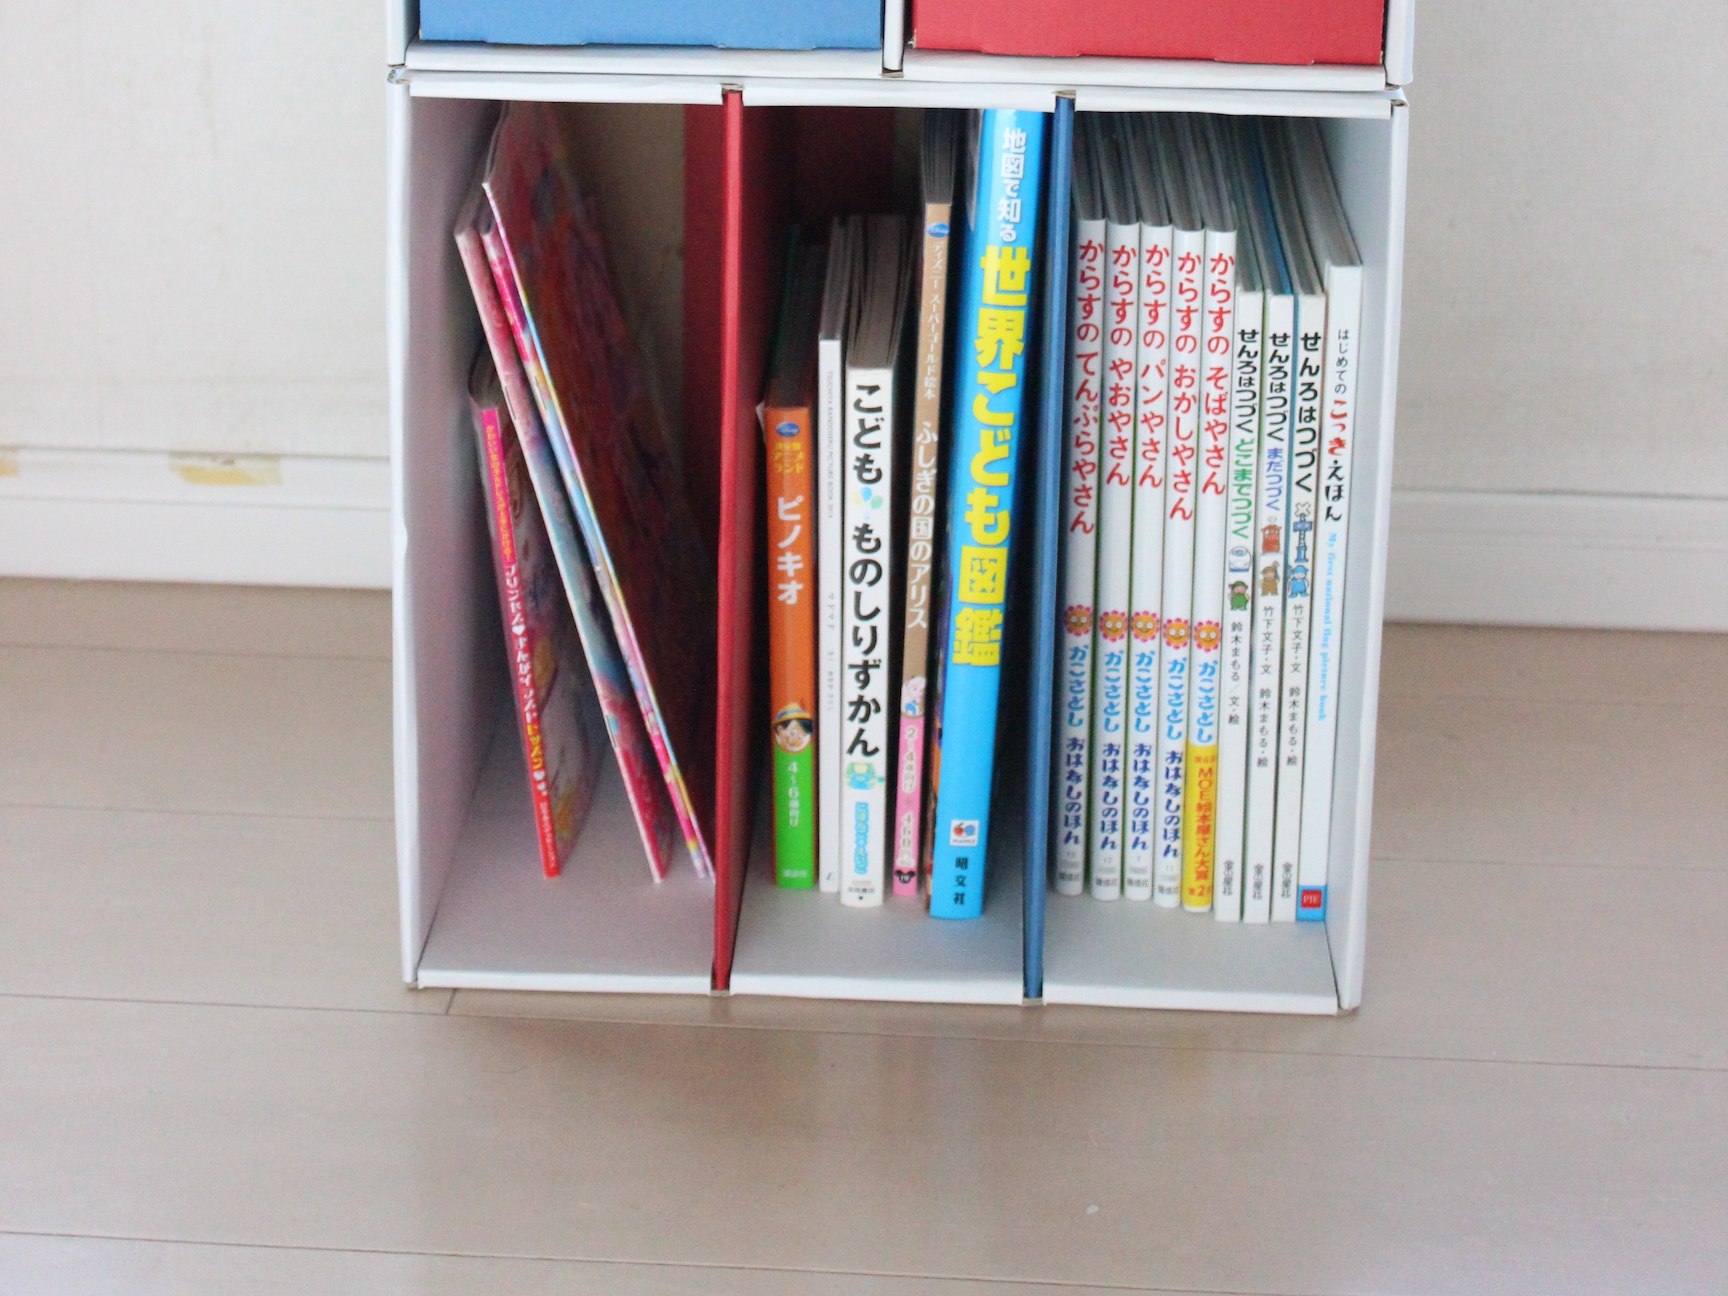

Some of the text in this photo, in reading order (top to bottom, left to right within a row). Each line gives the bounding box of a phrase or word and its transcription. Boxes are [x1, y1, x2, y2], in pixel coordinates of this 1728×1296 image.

[923, 241, 943, 401] ディズニー スーパーゴールド絵本
[1105, 244, 1137, 487] からすの やおやさん
[1138, 244, 1170, 489] からすの パンやさん
[1201, 253, 1235, 495] からすの そばやさん
[1333, 328, 1350, 396] はじめての
[952, 127, 1031, 667] 地図で知る 世界こども図鑑
[1070, 239, 1104, 535] からすの てんぷらやさん
[1169, 252, 1201, 521] からすの おかしやさん
[1230, 329, 1259, 539] せんろはつづく どこまでつづく
[1265, 332, 1291, 511] せんろはつづく まだつづく
[1295, 332, 1321, 494] せんろはつづく
[776, 495, 804, 605] ピノキオ
[846, 383, 884, 759] こども ものしりずかん
[907, 422, 939, 630] ふしぎの国のアリス
[1067, 644, 1090, 728] かこさとし
[1103, 650, 1125, 733] かこさとし
[1134, 650, 1155, 733] かこさとし
[1166, 657, 1187, 741] かこさとし
[1195, 660, 1218, 744] かこさとし
[1257, 605, 1274, 768] 竹下文子・文 鈴木まもる・絵
[1286, 604, 1304, 767] 竹下文子・文 鈴木まもる・絵
[1063, 737, 1085, 846] おはなしのほん
[1100, 743, 1121, 851] おはなしのほん
[1131, 743, 1151, 852] おはなしのほん
[1162, 750, 1183, 859] おはなしのほん
[954, 857, 969, 906] 昭文社
[1222, 859, 1234, 896] 金の星社
[1252, 864, 1264, 900] 金の星社
[1281, 862, 1293, 898] 金の星社
